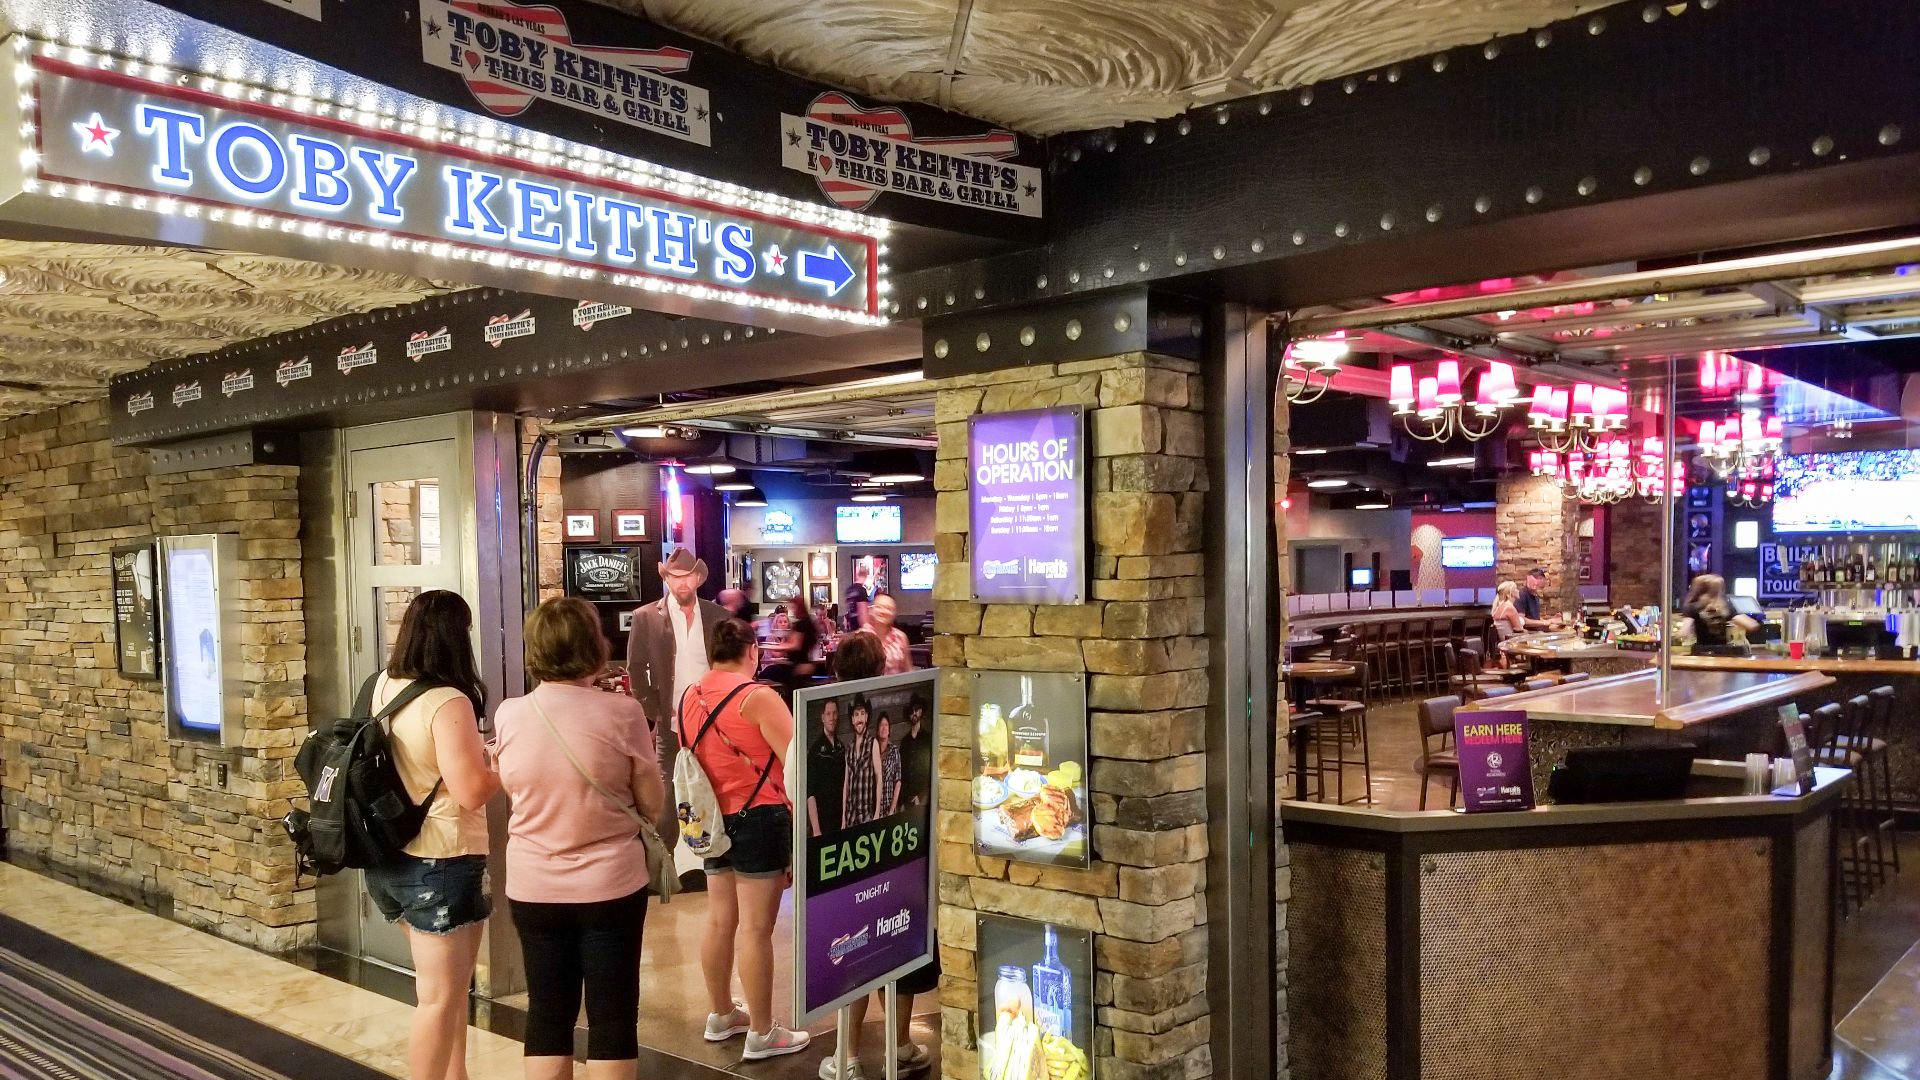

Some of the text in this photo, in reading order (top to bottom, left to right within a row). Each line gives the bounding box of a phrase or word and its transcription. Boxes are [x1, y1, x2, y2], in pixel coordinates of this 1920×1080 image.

[447, 10, 688, 113] TOBY KEITH'S
[450, 43, 691, 135] I THIS BAR & GRILL
[805, 122, 1019, 192] TOBY KEITH'S
[136, 103, 756, 283] TOBY KEITH'S
[807, 151, 1020, 212] I THIS BAR & GRILL
[489, 324, 504, 334] TOBY
[982, 438, 1068, 465] HOURS OF
[976, 459, 1074, 486] OPERATION
[579, 556, 629, 574] JACK DANIEL'S
[1464, 724, 1522, 736] EARN HERE
[820, 822, 918, 882] EASY 8's
[854, 881, 890, 904] TONIGHT AT
[876, 908, 910, 938] Harrah's
